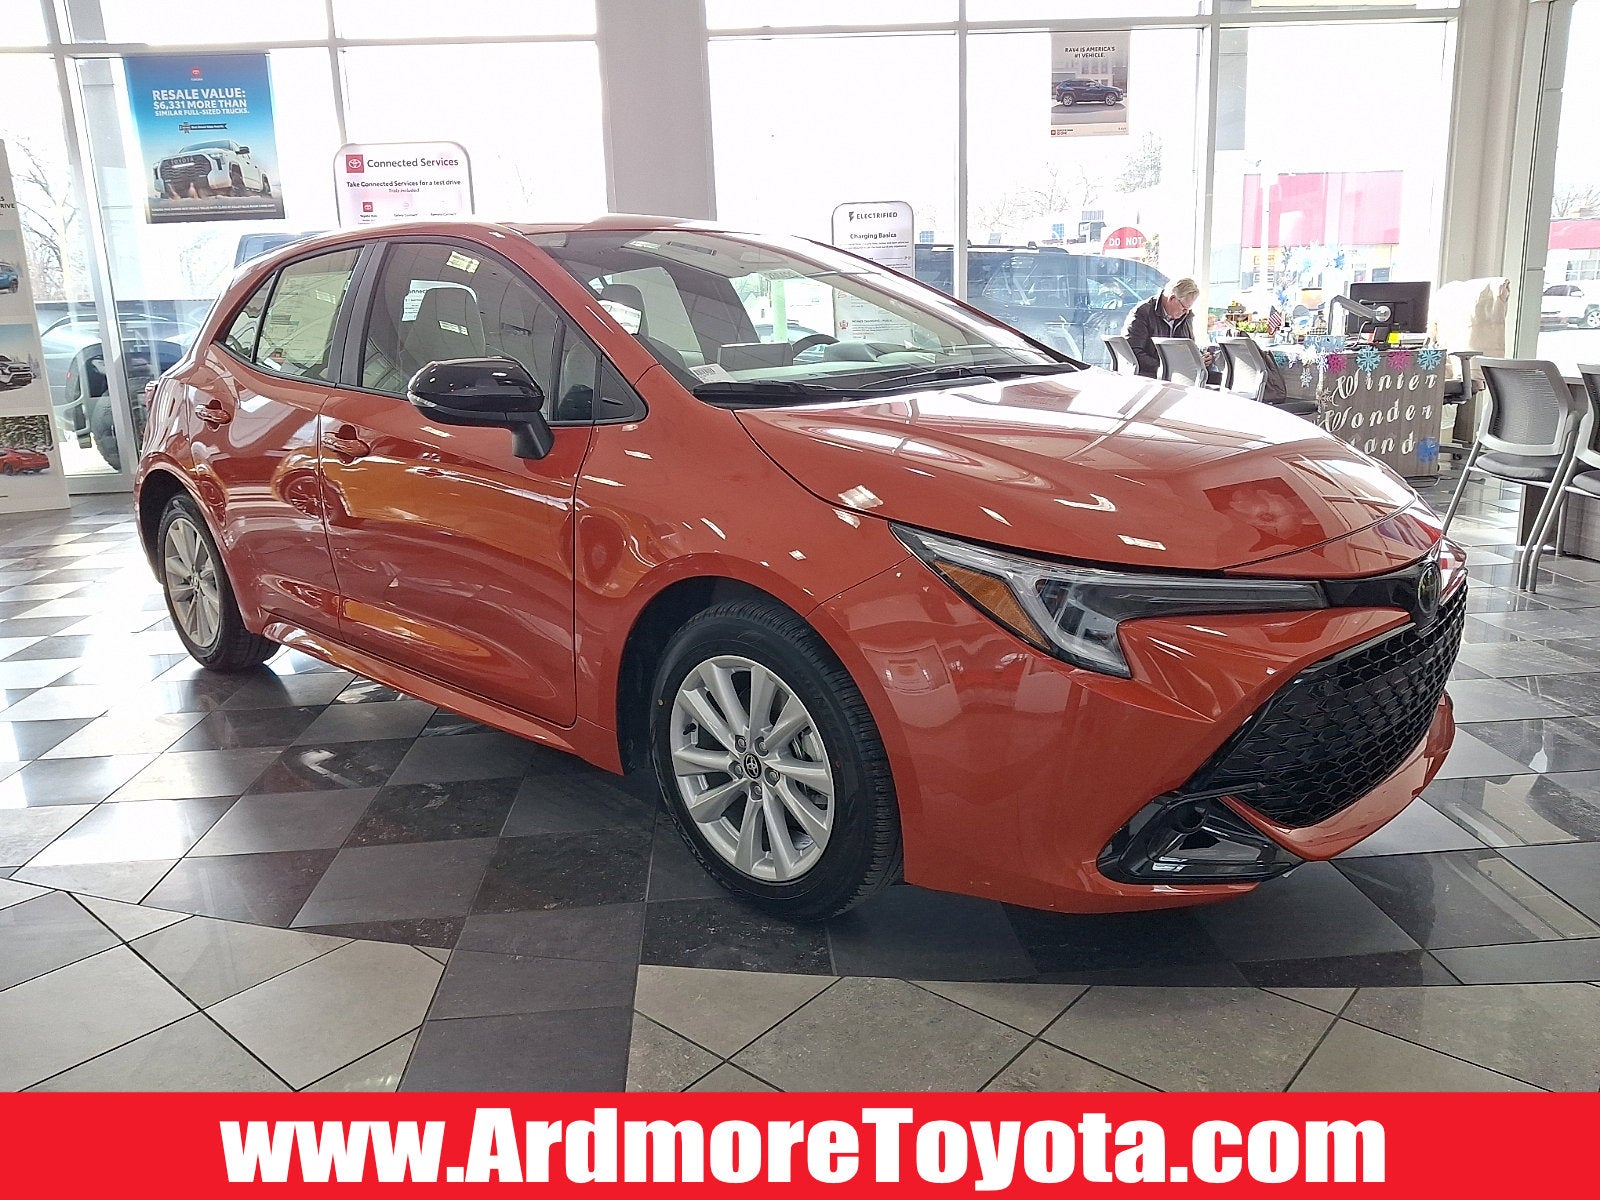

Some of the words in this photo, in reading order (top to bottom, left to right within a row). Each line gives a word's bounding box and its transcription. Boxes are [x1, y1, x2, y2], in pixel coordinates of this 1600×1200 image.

[152, 89, 200, 101] RESALE
[201, 87, 246, 99] VALUE:
[153, 100, 186, 110] $6,331
[187, 100, 217, 109] MORE
[218, 99, 247, 108] THAN
[155, 109, 183, 117] SIMILAR
[183, 108, 220, 116] FULL-SIZED
[367, 158, 418, 168] Connected
[420, 157, 459, 167] Services
[856, 212, 898, 220] ELECTRIFIED
[1109, 237, 1121, 246] DO
[1126, 236, 1143, 246] NOT
[1331, 368, 1438, 407] Winter
[1318, 398, 1433, 433] Wonder
[1350, 431, 1416, 455] and
